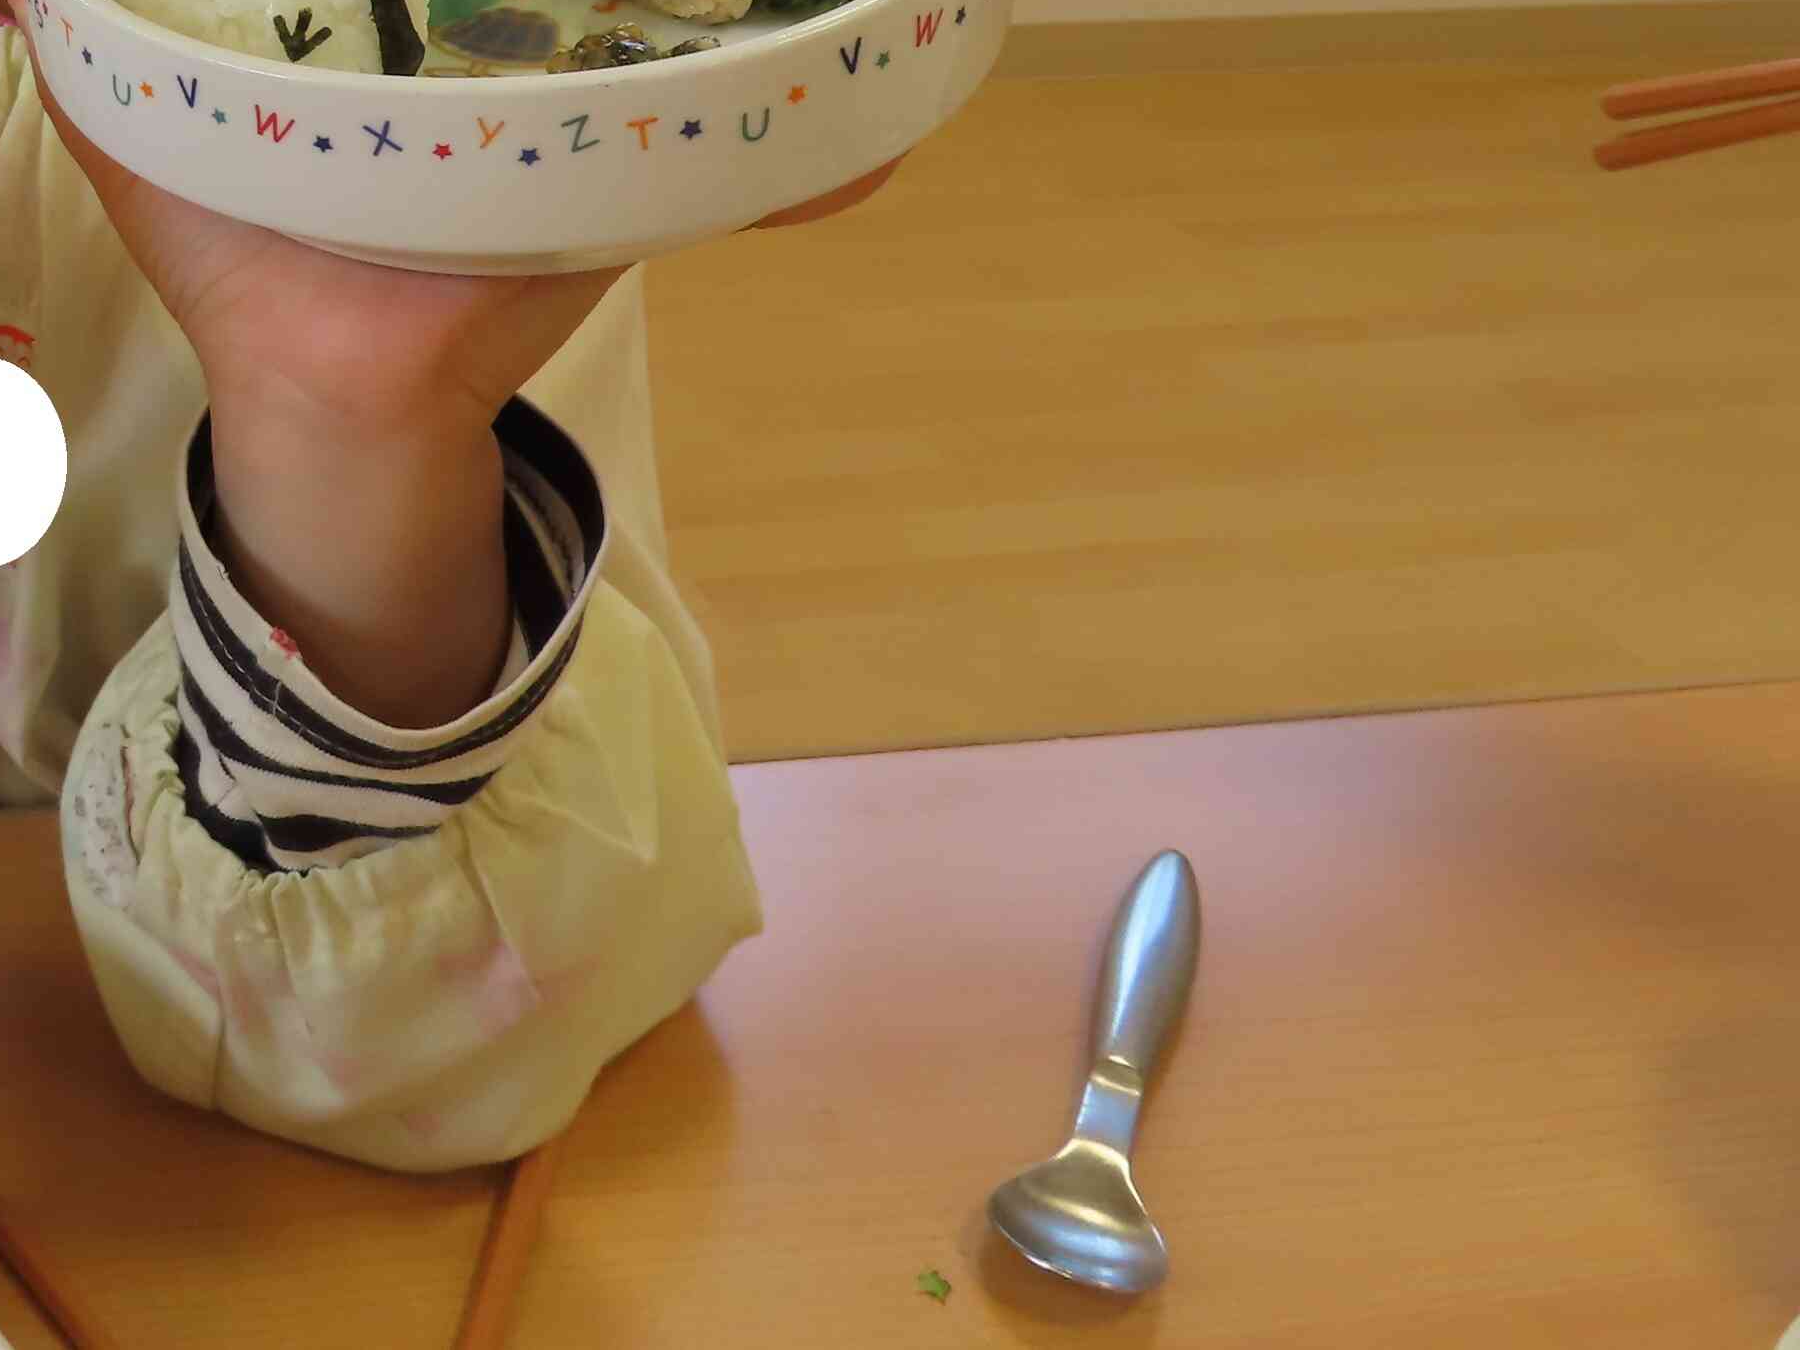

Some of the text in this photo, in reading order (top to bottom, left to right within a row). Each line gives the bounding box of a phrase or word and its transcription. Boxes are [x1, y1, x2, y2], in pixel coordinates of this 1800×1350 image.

[113, 74, 131, 106] U
[177, 75, 198, 109] V
[255, 104, 295, 143] W
[363, 120, 403, 157] X
[477, 117, 505, 149] Y
[561, 114, 600, 153] Z
[627, 117, 659, 150] T
[742, 108, 770, 142] U
[840, 37, 862, 74] V
[913, 8, 944, 48] W
